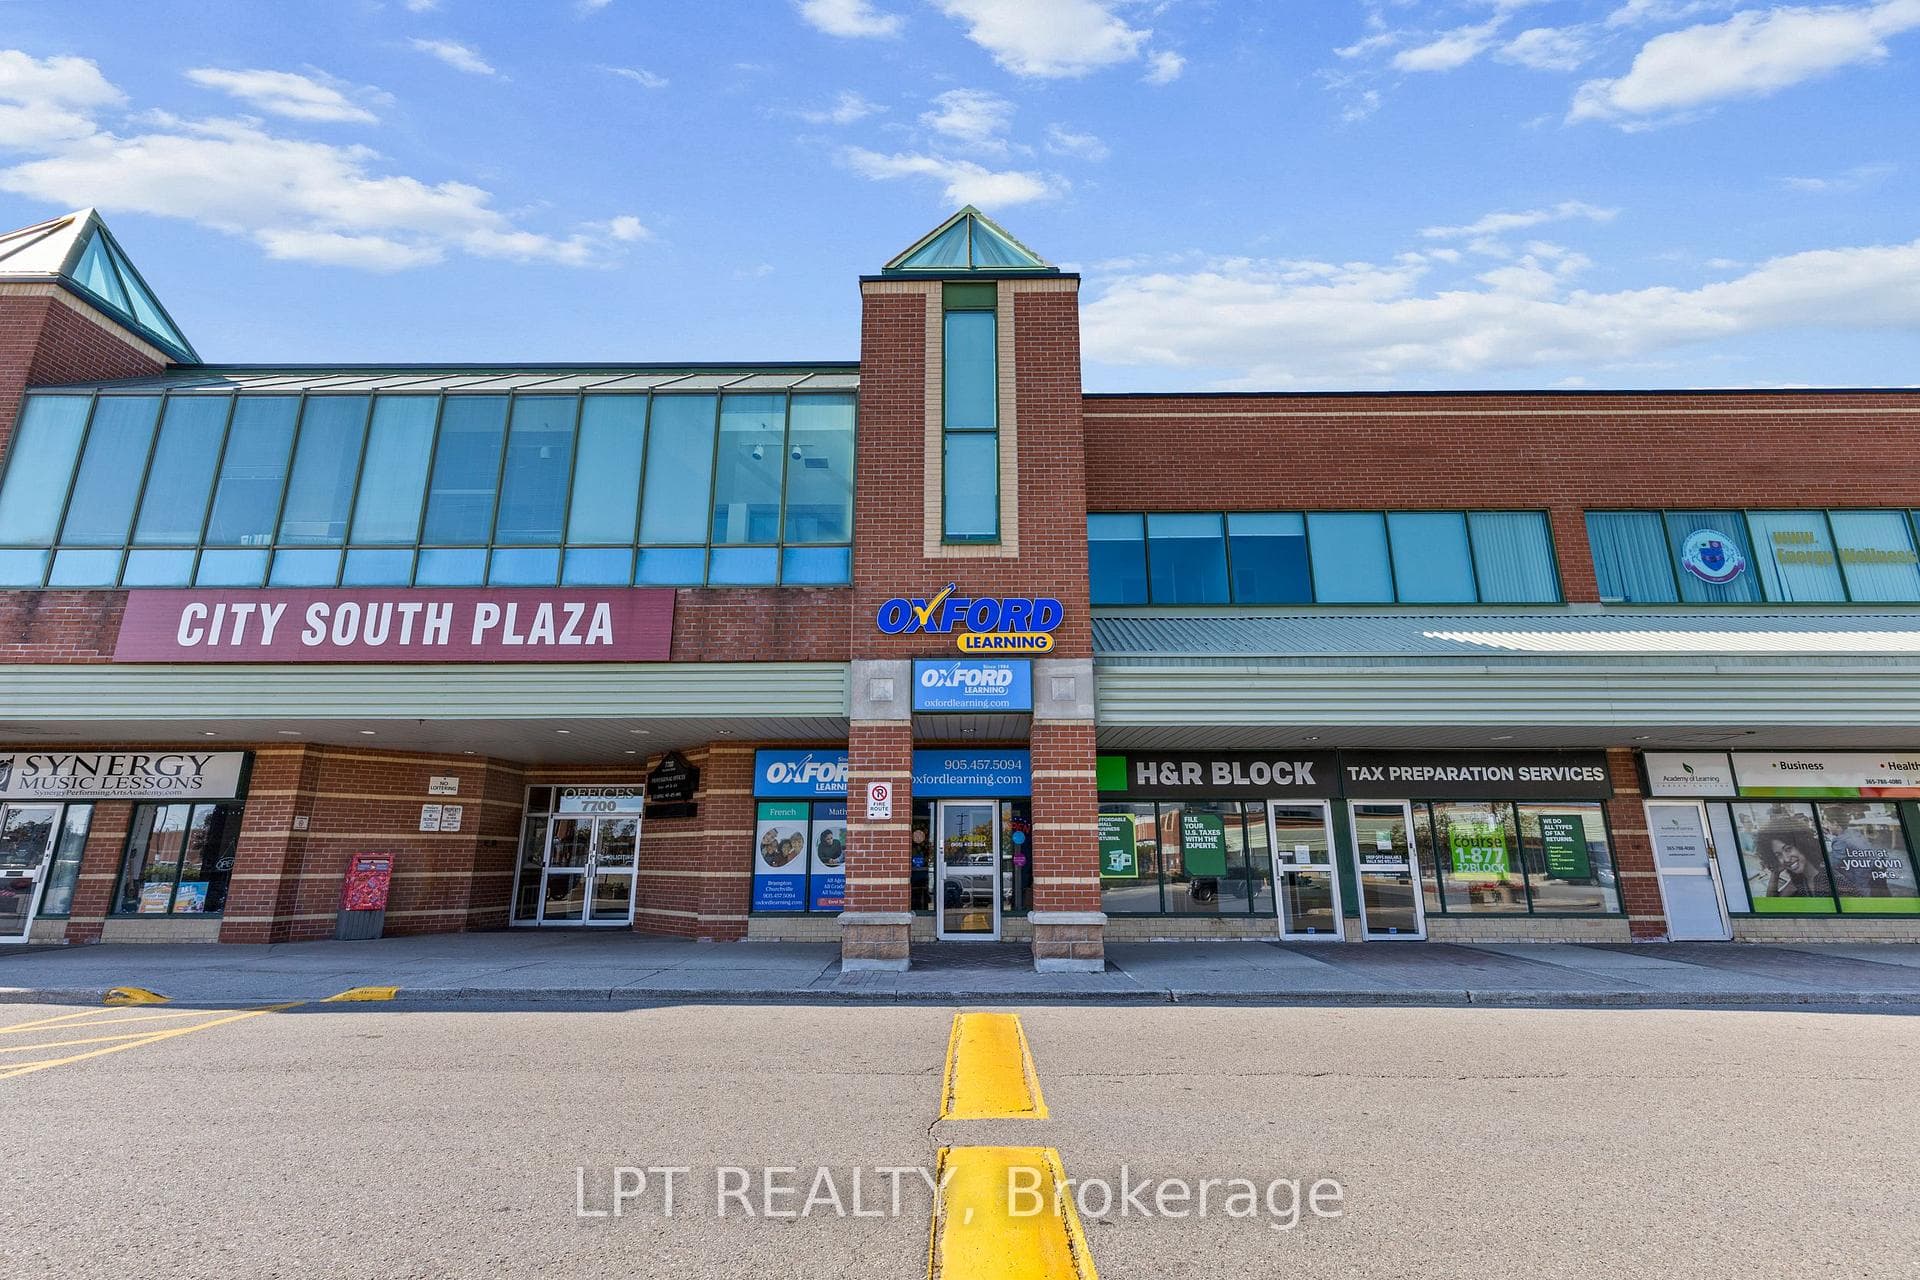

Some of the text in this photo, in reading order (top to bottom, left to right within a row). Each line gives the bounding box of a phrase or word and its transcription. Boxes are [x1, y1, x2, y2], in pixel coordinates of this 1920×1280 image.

[877, 582, 1064, 634] OXFORD
[177, 602, 614, 646] CITY SOUTH PLAZA
[966, 636, 1047, 649] LEARNING
[921, 662, 1013, 687] OXFORD
[965, 686, 1005, 694] LEARNING
[924, 698, 1009, 709] oxfordlearning.com
[22, 754, 215, 777] SYNERGY
[767, 754, 848, 783] OXFOR
[944, 759, 1022, 770] 905.457.5094
[1780, 761, 1824, 771] Business
[1136, 761, 1316, 785] H&R BLOCK
[1347, 766, 1605, 782] TAX PREPARATION SERVICES
[18, 776, 203, 790] MUSIC LESSONS
[1663, 775, 1688, 783] Academy
[1696, 775, 1720, 783] Learning
[815, 783, 847, 791] LEARNI
[34, 789, 183, 797] SynergyPerformingArtsAcademy.com
[564, 787, 635, 799] OFFICES
[581, 801, 617, 811] 7700
[769, 808, 797, 816] French
[1454, 837, 1502, 848] course
[1455, 847, 1504, 863] 1-877
[1846, 848, 1888, 858] Learn at
[1457, 863, 1505, 873] 32BLOCK
[1843, 859, 1902, 871] your own
